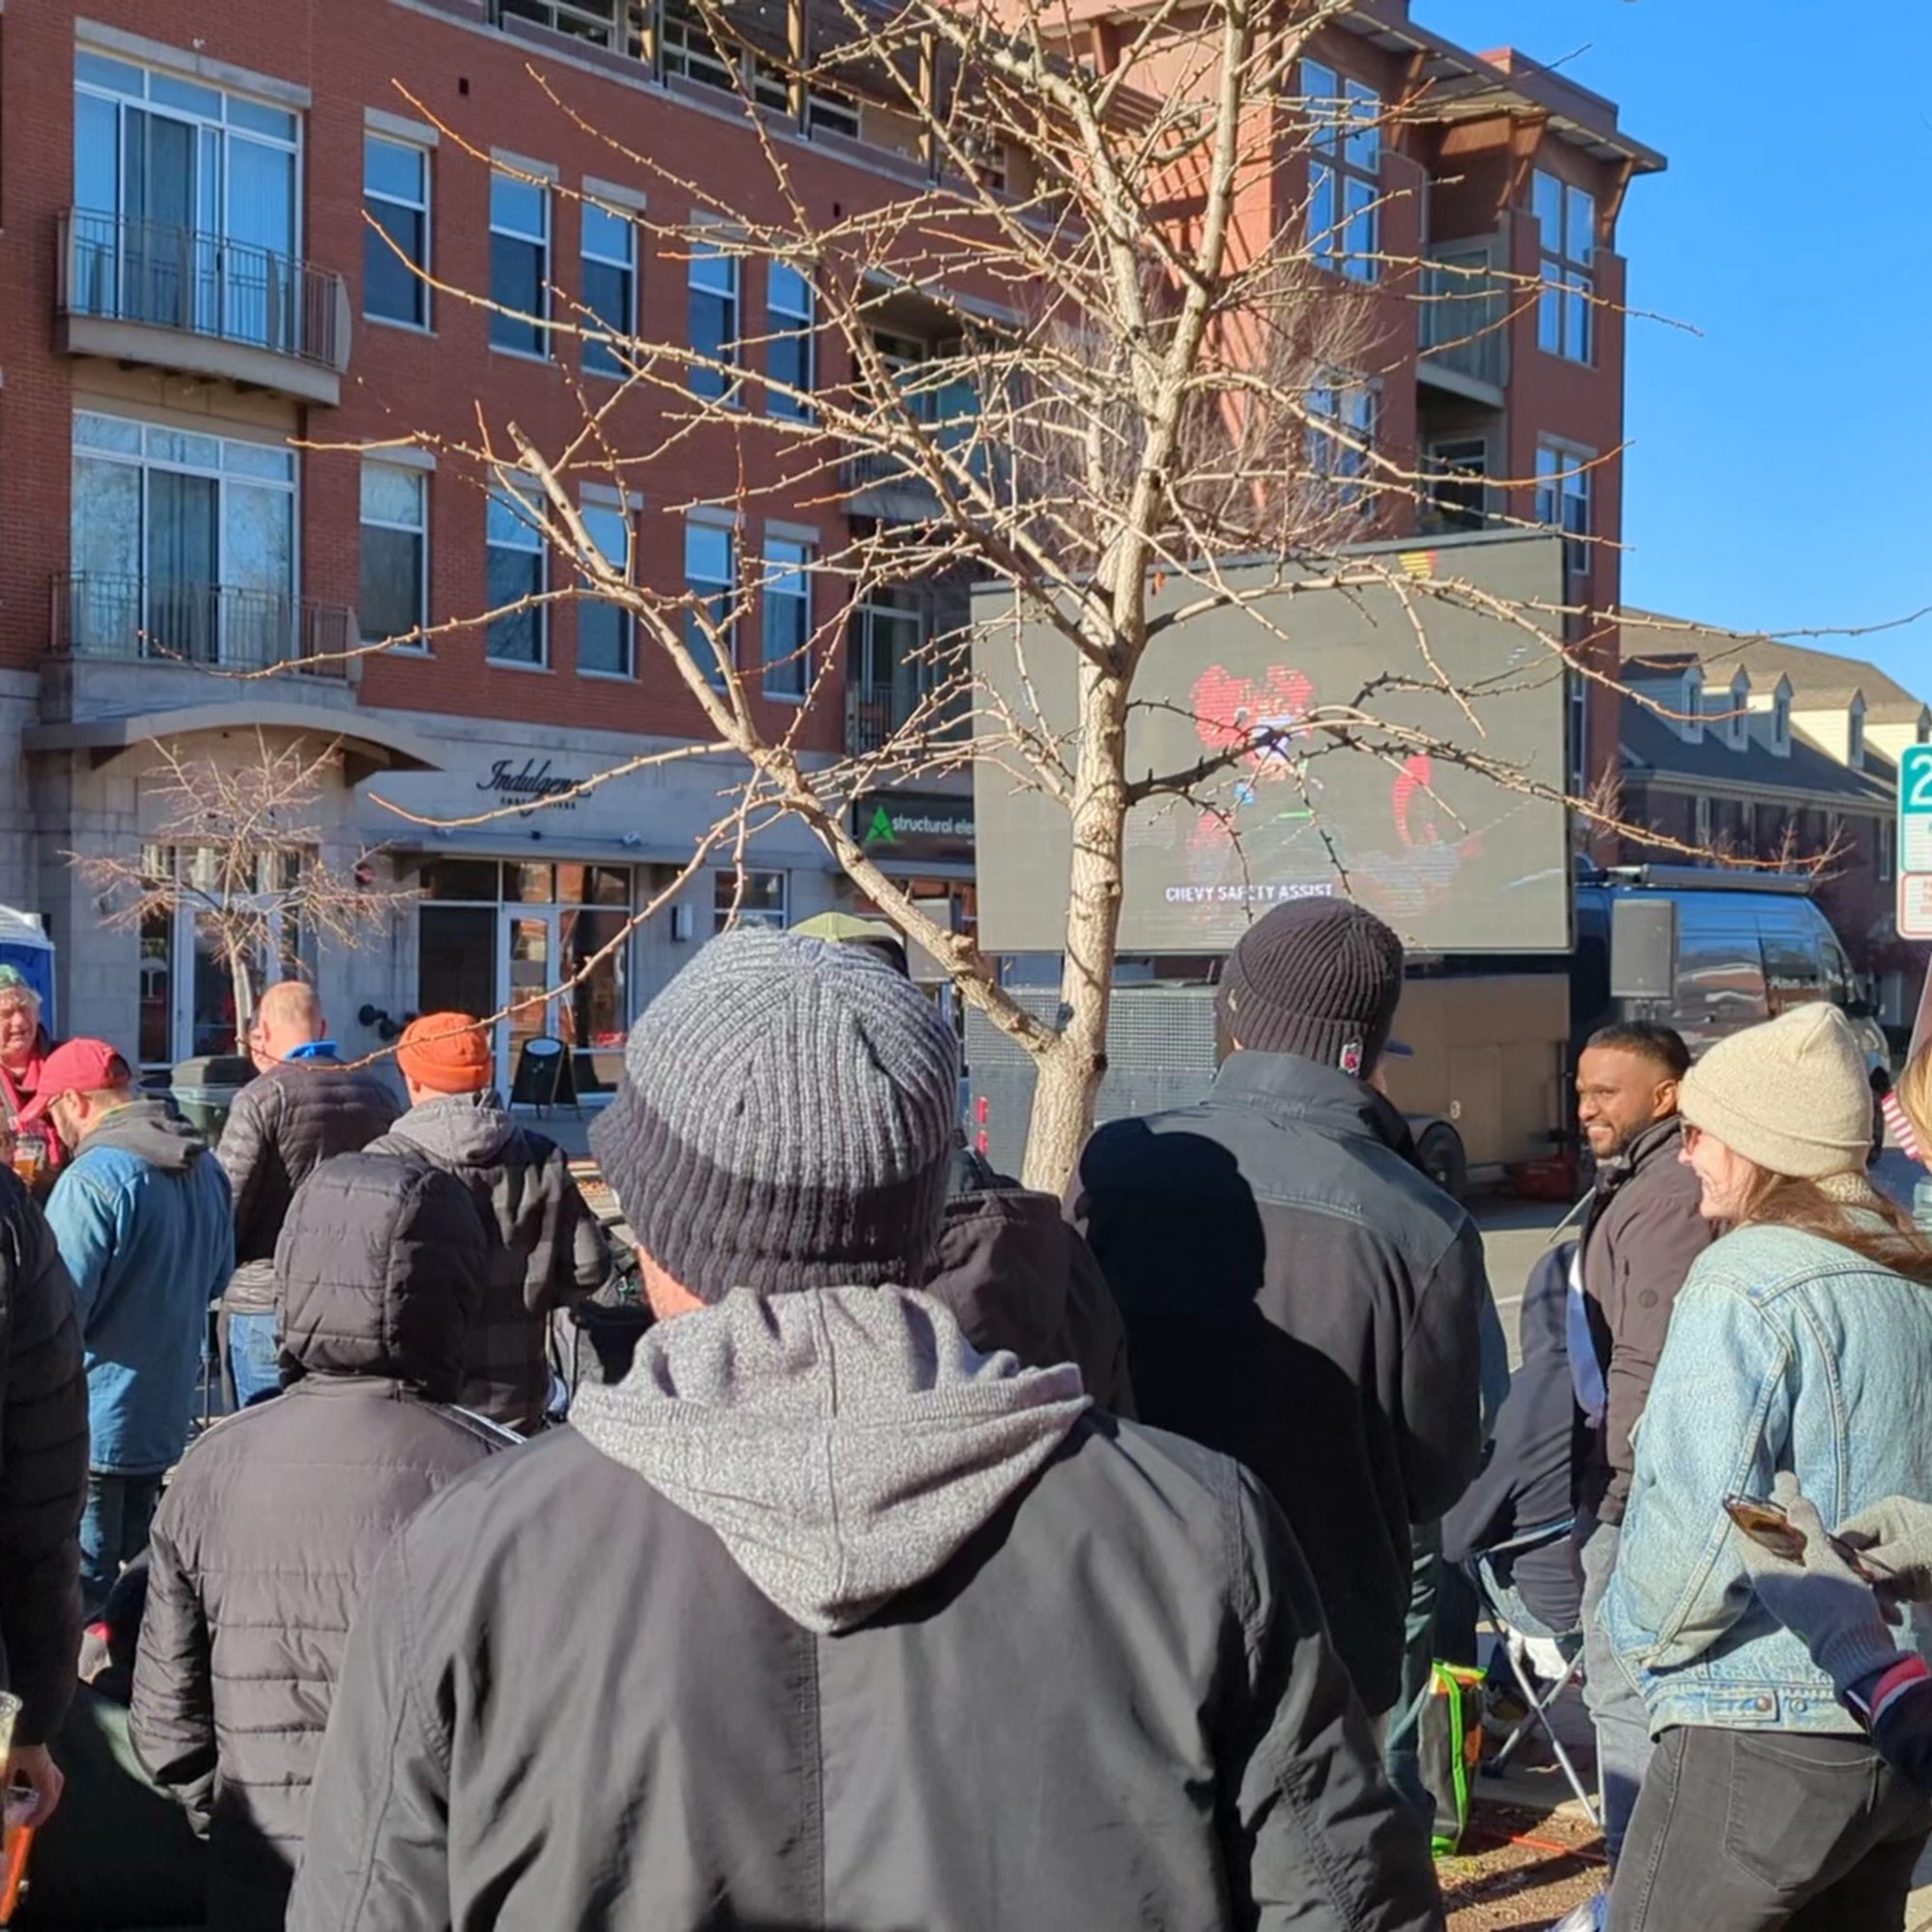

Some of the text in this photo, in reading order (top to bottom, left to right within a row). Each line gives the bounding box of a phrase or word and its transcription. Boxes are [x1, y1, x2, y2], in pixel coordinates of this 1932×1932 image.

[476, 757, 592, 817] Indulgen
[1910, 754, 1932, 806] 2
[892, 814, 953, 834] structural
[1165, 884, 1332, 902] CHEVY SAFETY ASSIST
